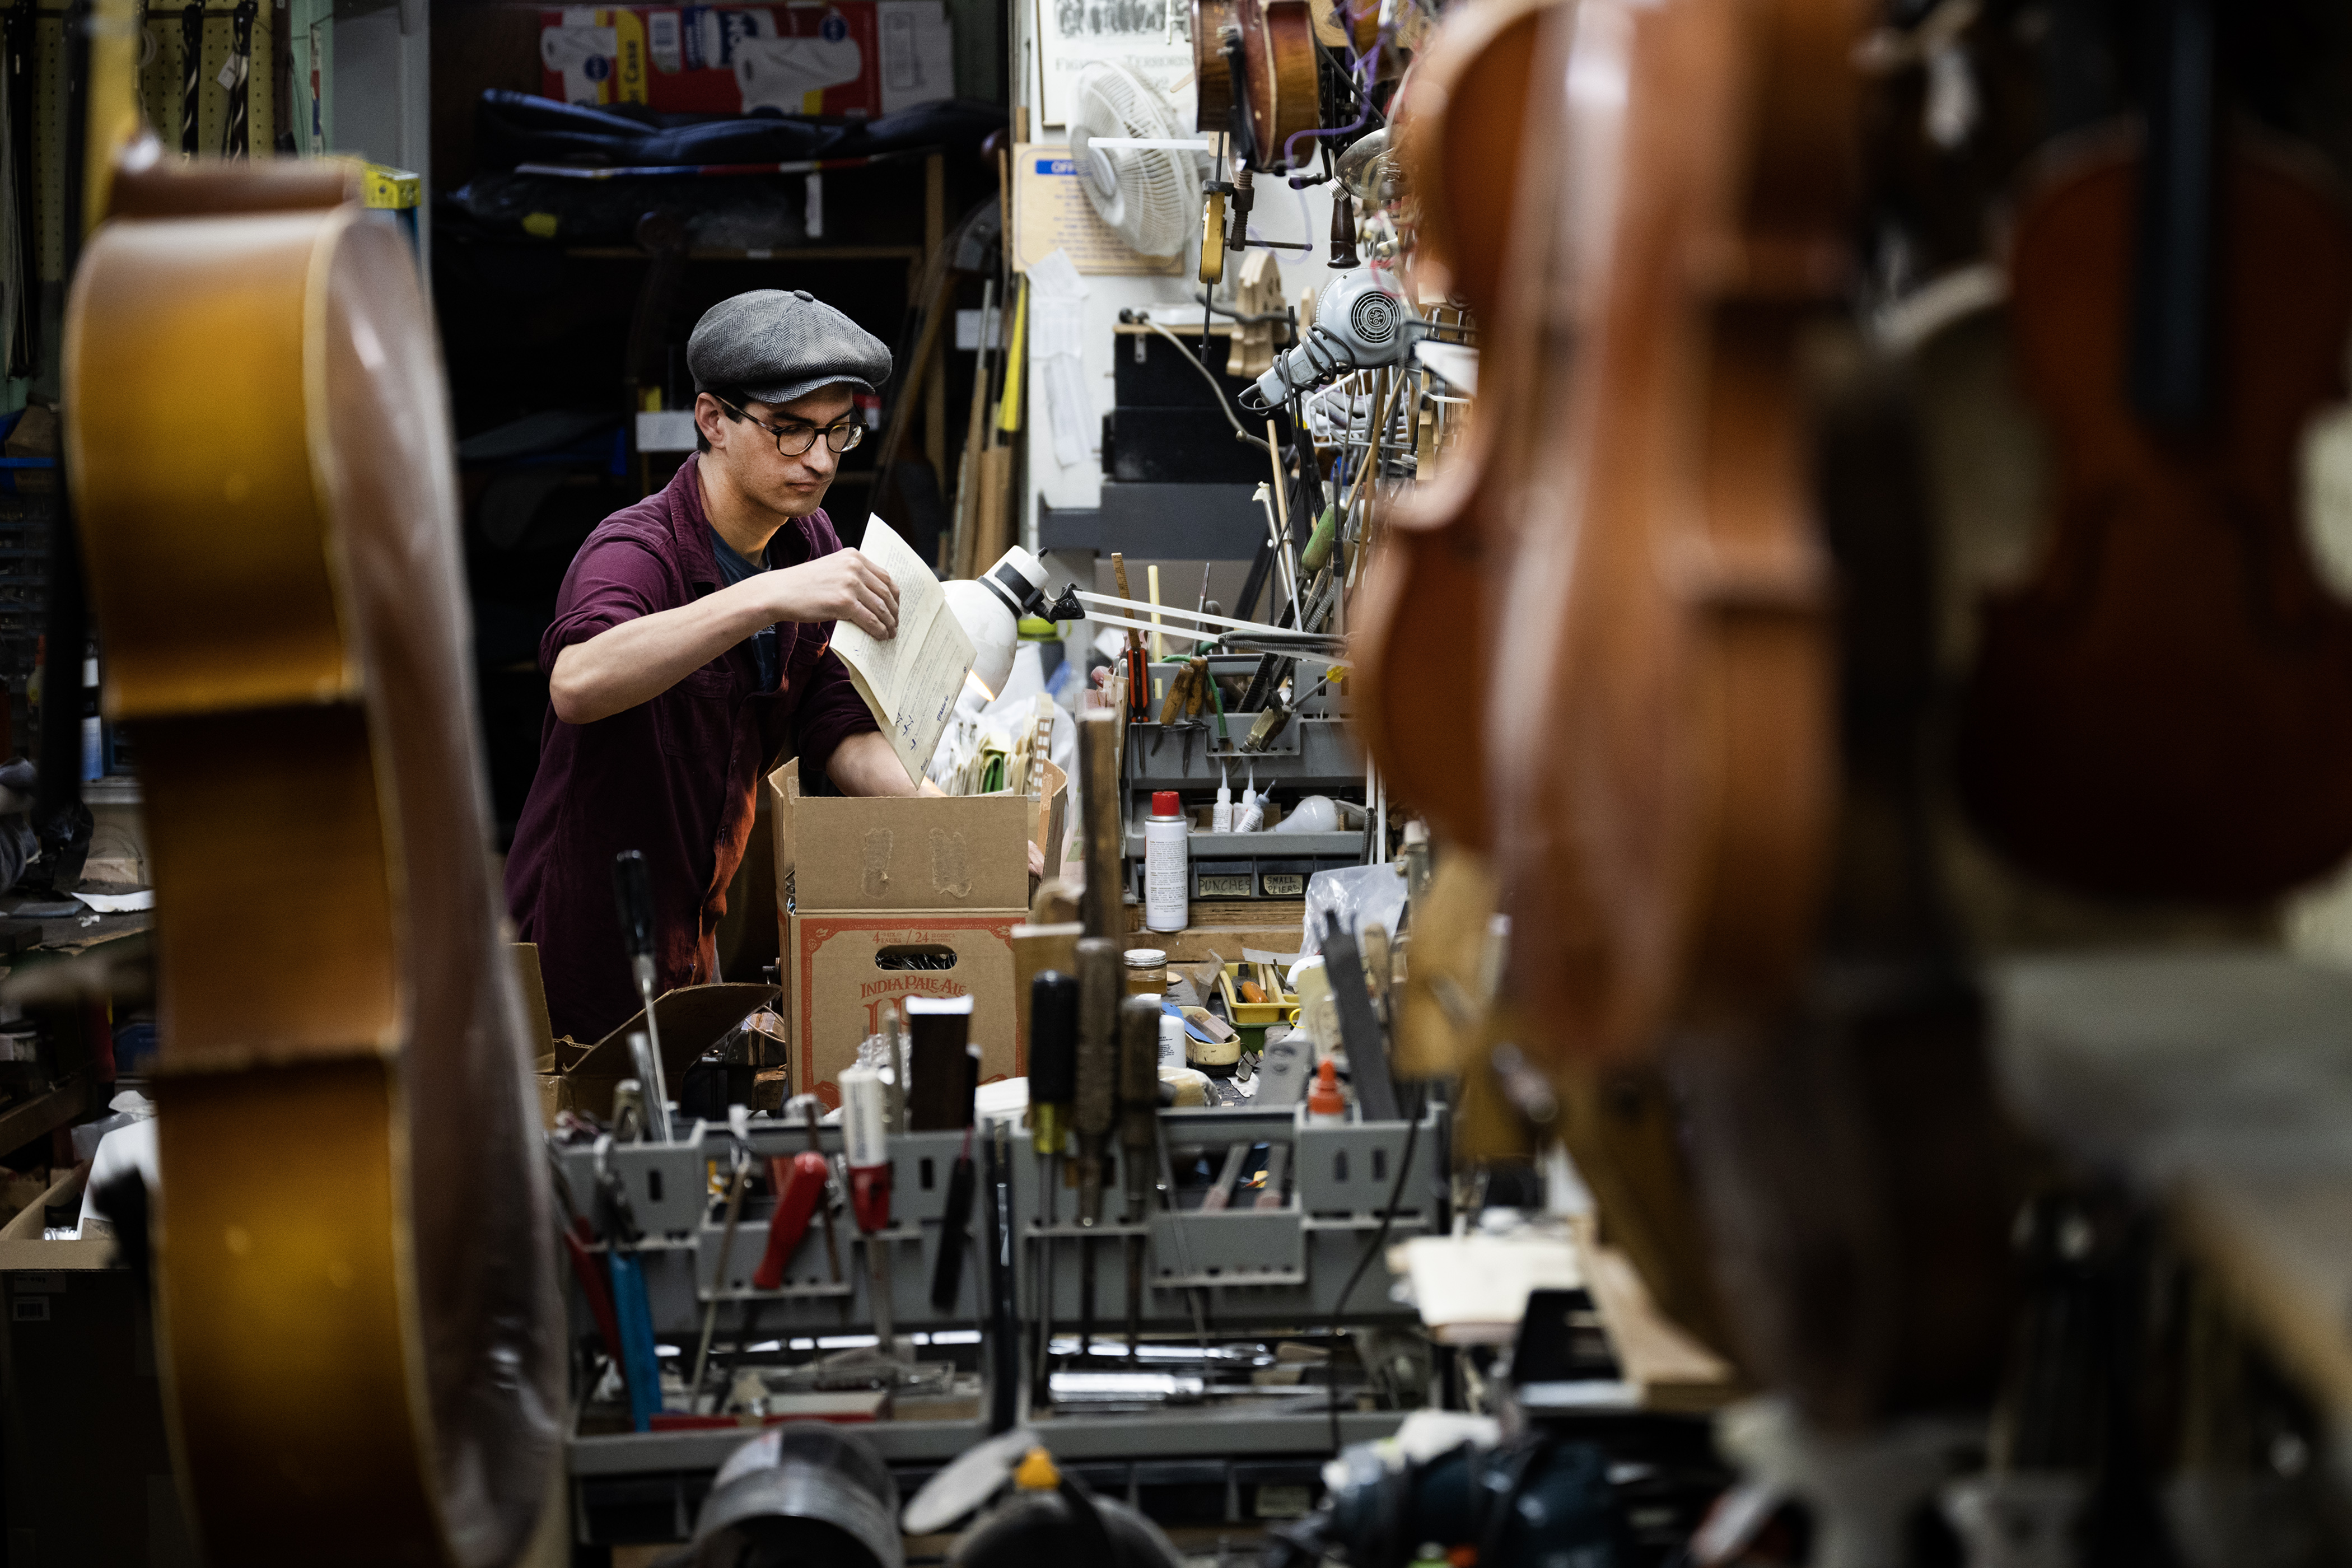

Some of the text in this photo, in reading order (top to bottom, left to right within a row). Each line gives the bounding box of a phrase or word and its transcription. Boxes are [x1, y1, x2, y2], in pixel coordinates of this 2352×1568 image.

[1198, 879, 1250, 891] PUNCHES
[1266, 876, 1296, 884] SMALL
[872, 931, 880, 944] 4
[915, 931, 929, 943] 24
[860, 975, 967, 999] INDIA PALE ALE
